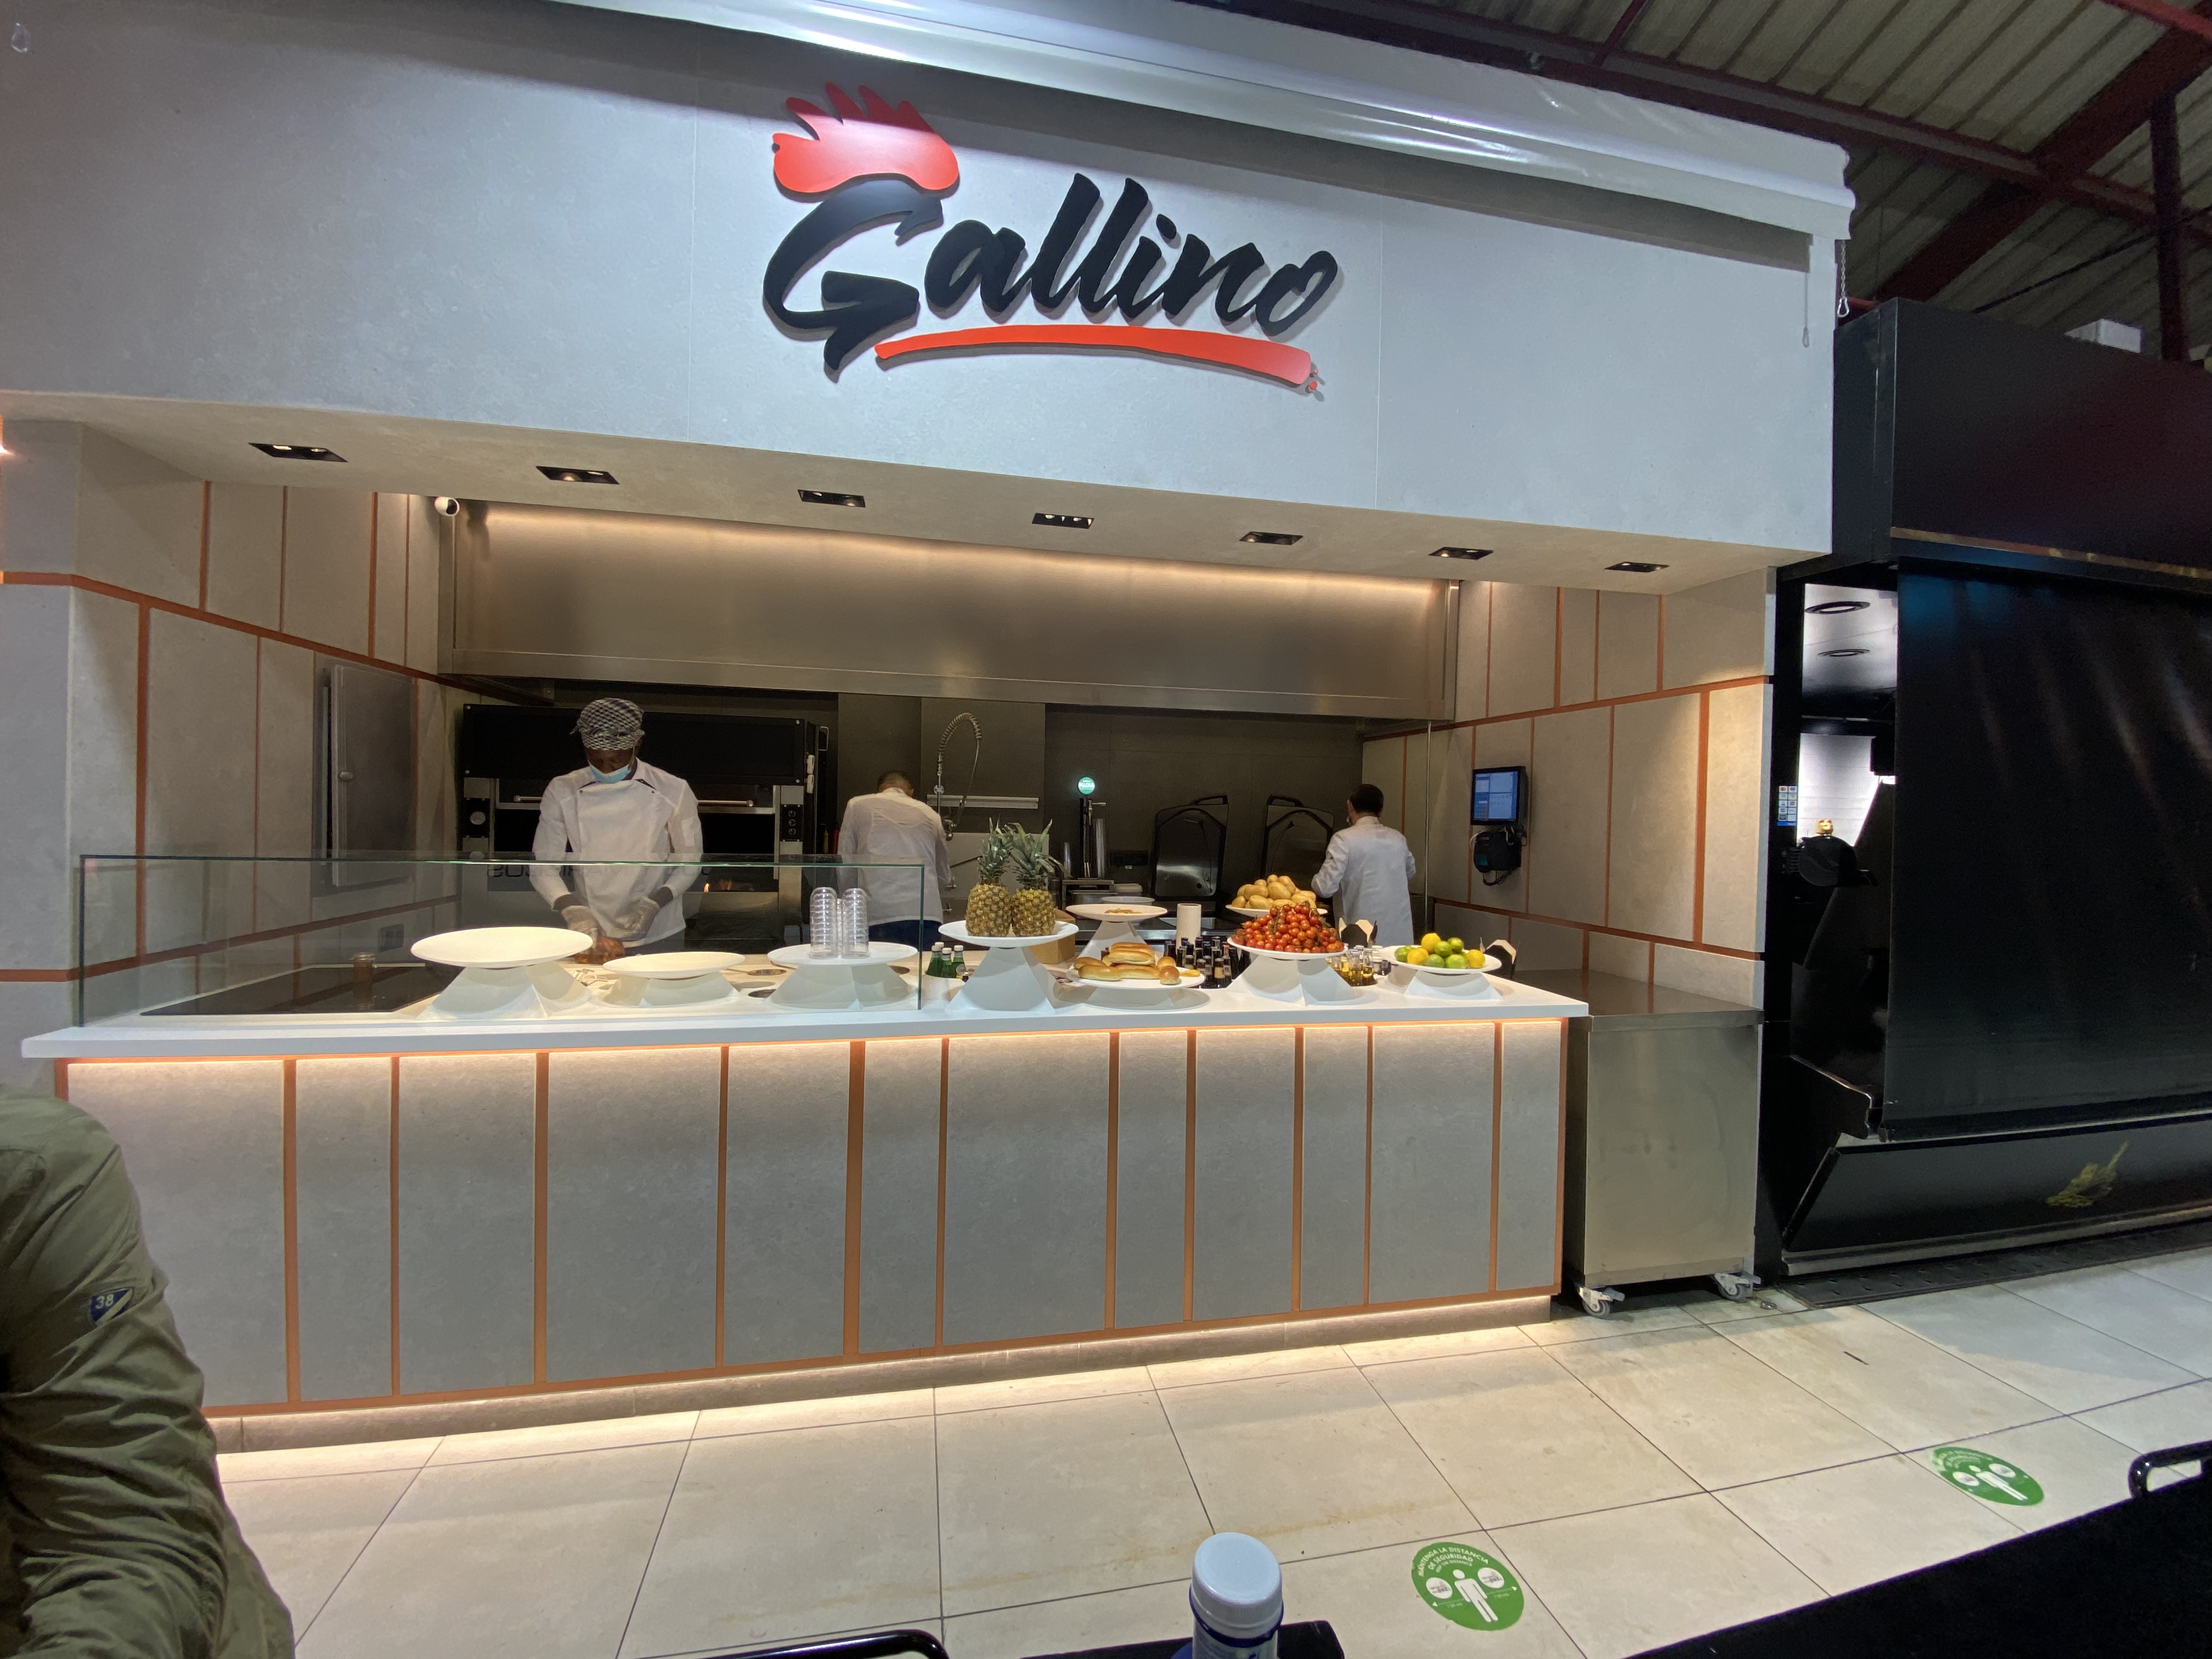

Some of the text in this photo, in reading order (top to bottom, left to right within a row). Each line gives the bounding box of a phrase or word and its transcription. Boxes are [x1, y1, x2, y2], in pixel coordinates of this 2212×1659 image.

[763, 172, 1338, 371] Gallino
[95, 1294, 115, 1310] 38
[1427, 1561, 1436, 1570] DE
[1434, 1553, 1474, 1564] SEGURIDAD
[1448, 1547, 1488, 1564] DISTANCIA
